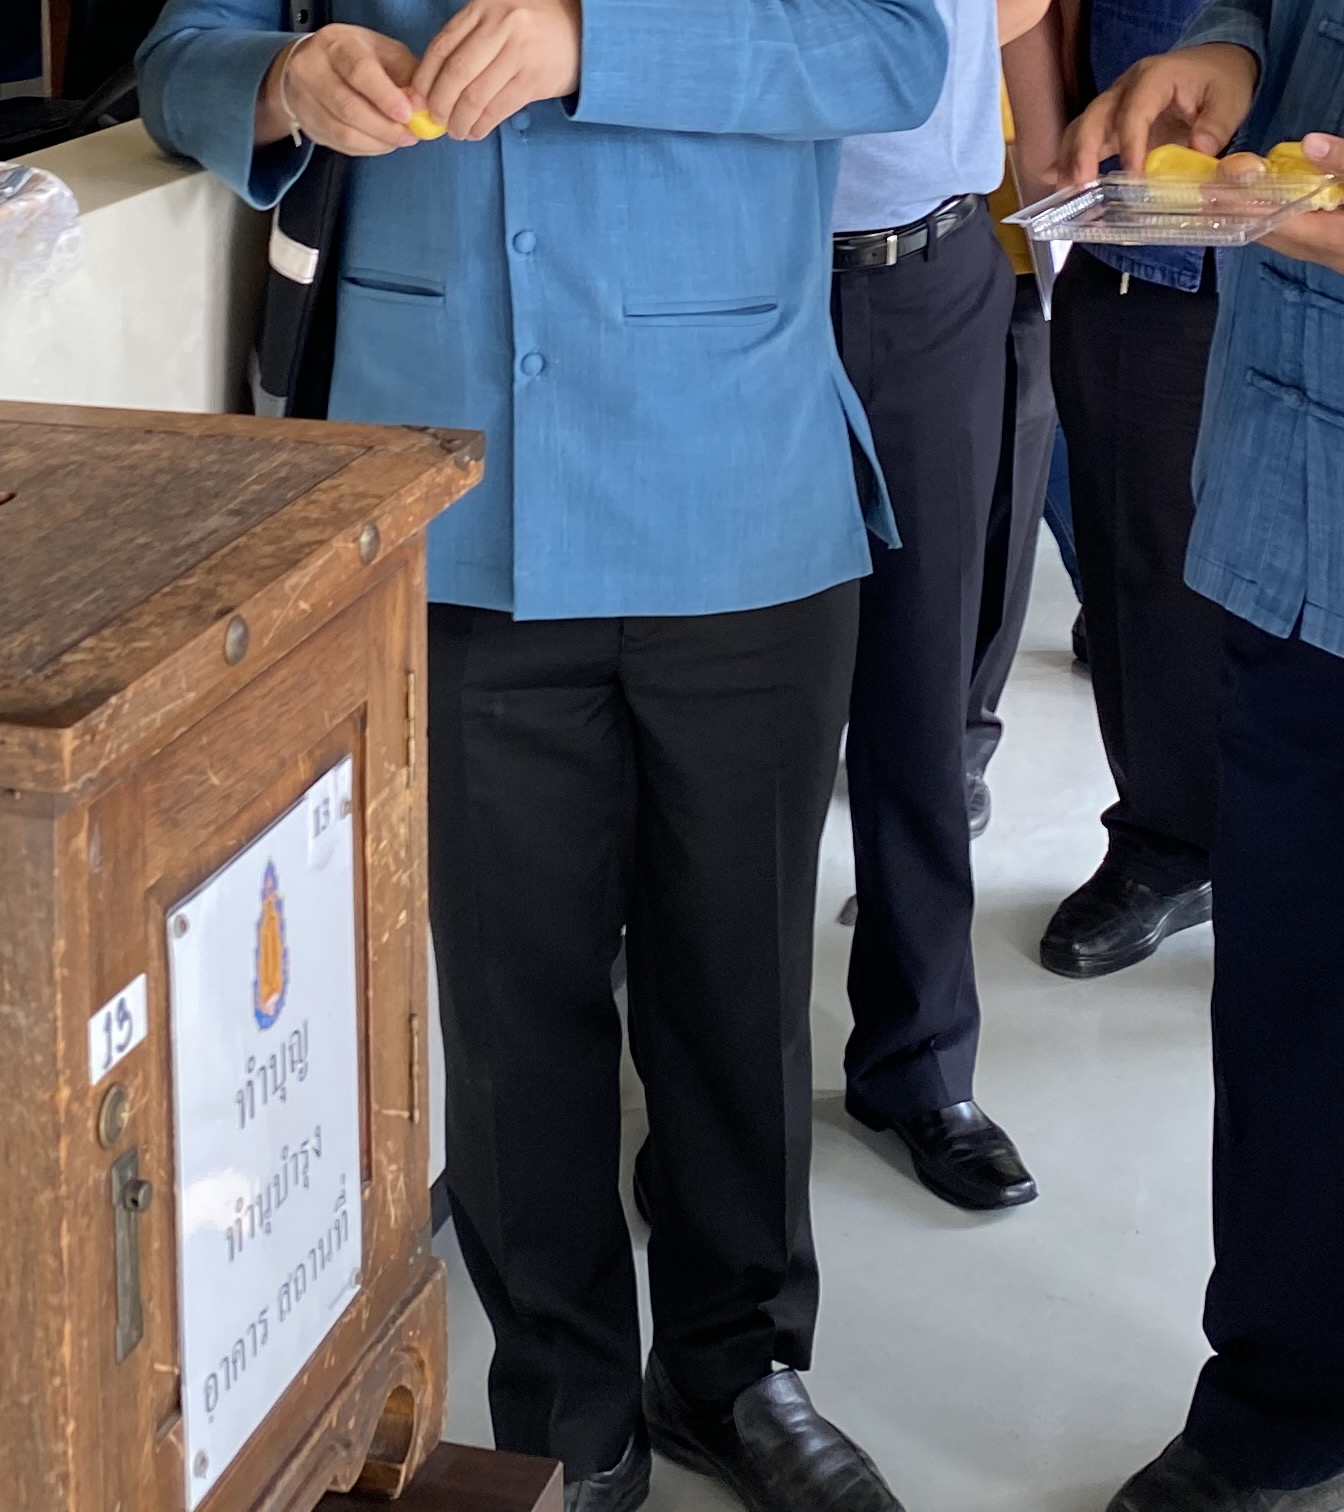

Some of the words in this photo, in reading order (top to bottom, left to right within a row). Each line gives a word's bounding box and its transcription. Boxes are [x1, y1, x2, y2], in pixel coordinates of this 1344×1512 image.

[234, 1018, 309, 1131] ทำบุญ
[225, 1124, 322, 1263] ทำนุบำรุง
[203, 1304, 270, 1415] อาคาร
[278, 1172, 350, 1323] สถานที่
